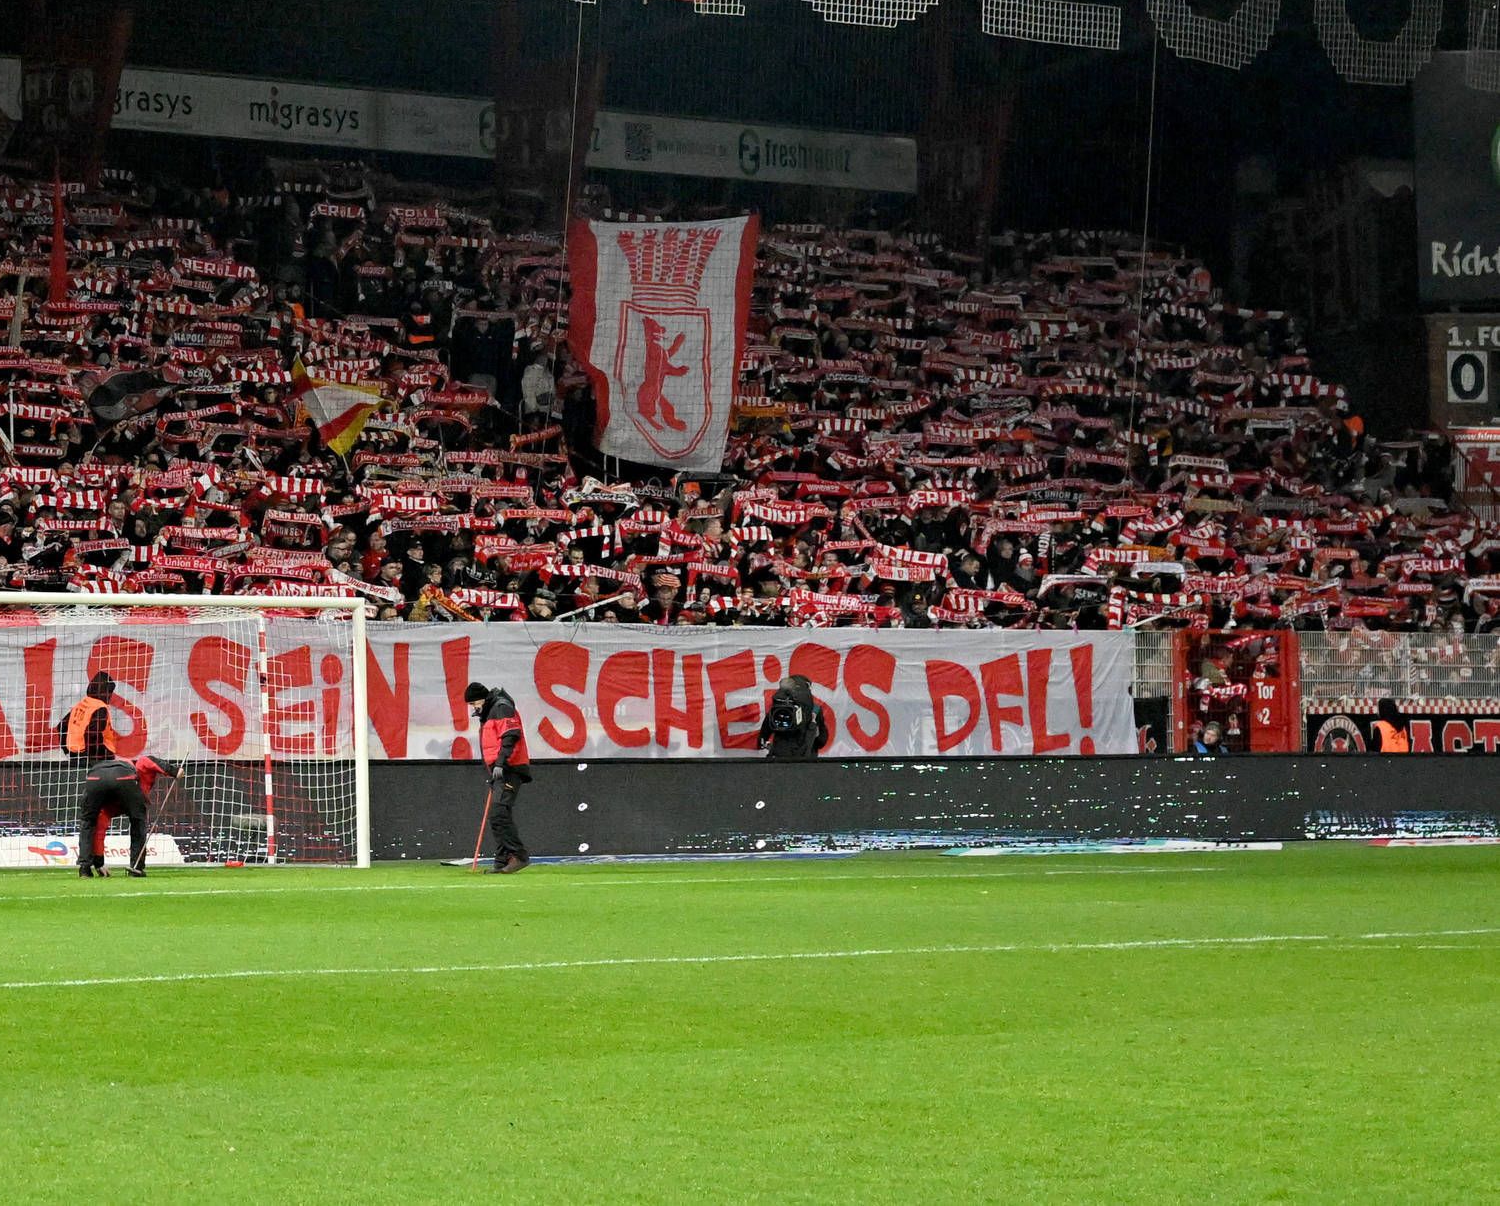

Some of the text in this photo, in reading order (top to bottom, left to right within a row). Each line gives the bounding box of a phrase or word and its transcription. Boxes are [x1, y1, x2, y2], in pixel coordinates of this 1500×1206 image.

[1450, 353, 1485, 401] 0
[247, 564, 280, 576] Union
[281, 565, 312, 579] Berlin
[925, 643, 1094, 756] DFL!
[1256, 681, 1275, 700] Tor
